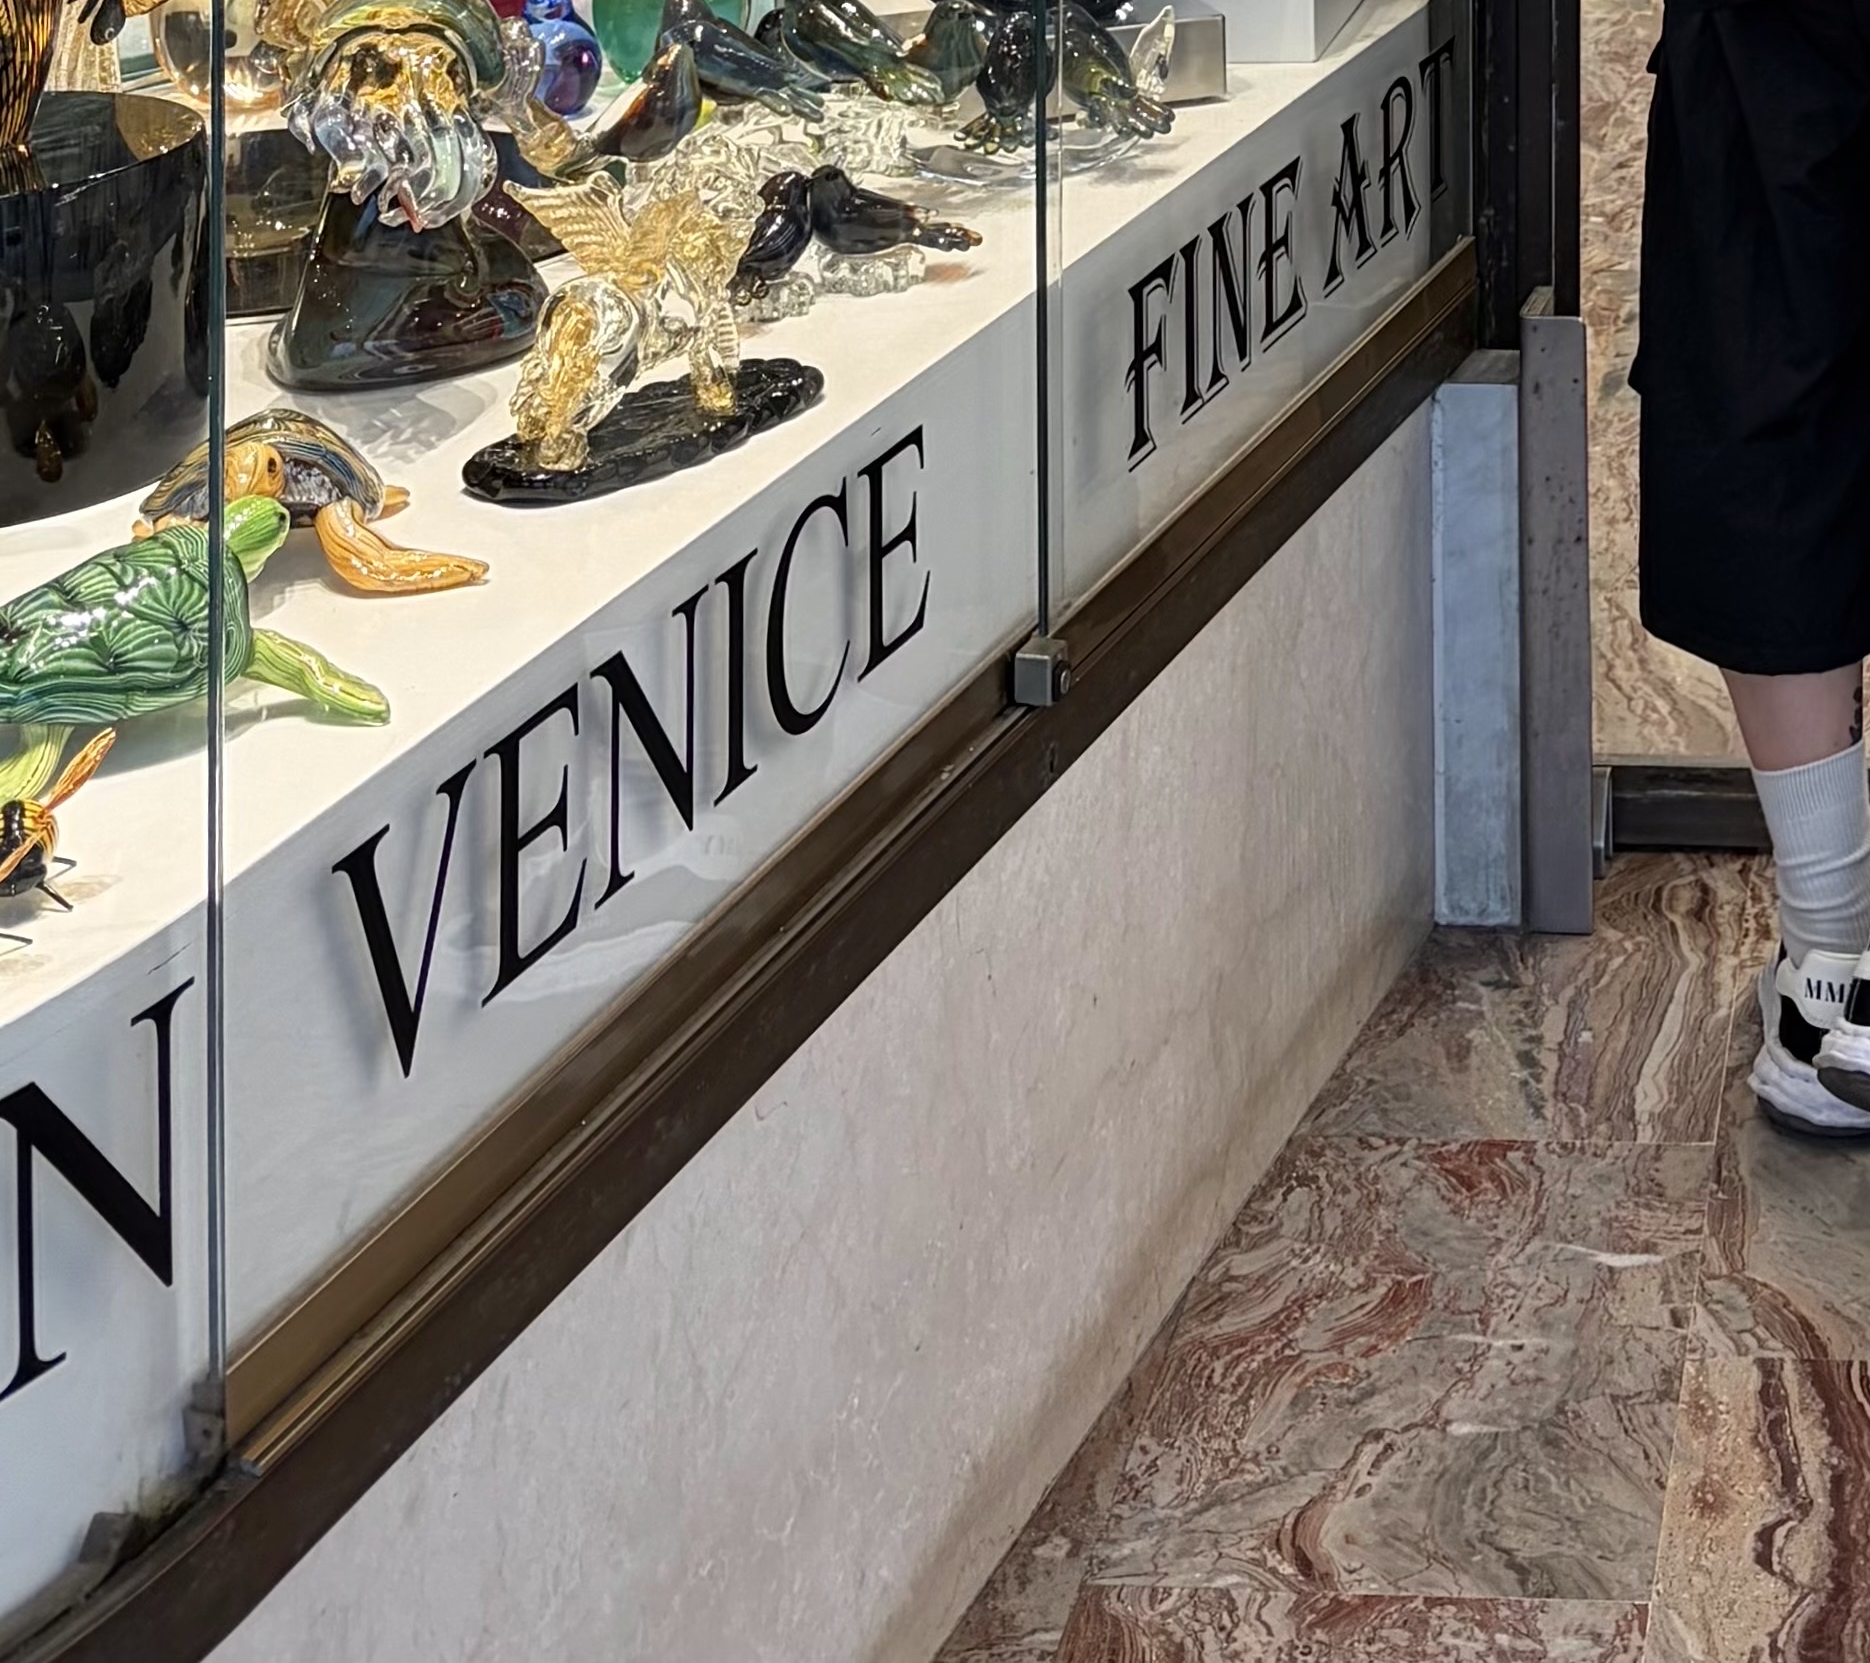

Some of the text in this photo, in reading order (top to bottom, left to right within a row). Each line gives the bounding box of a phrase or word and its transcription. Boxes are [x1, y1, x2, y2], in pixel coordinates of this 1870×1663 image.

[333, 425, 931, 1079] VENICE
[1123, 154, 1308, 473] FINE
[1322, 34, 1456, 299] ART
[1804, 977, 1853, 1005] MM
